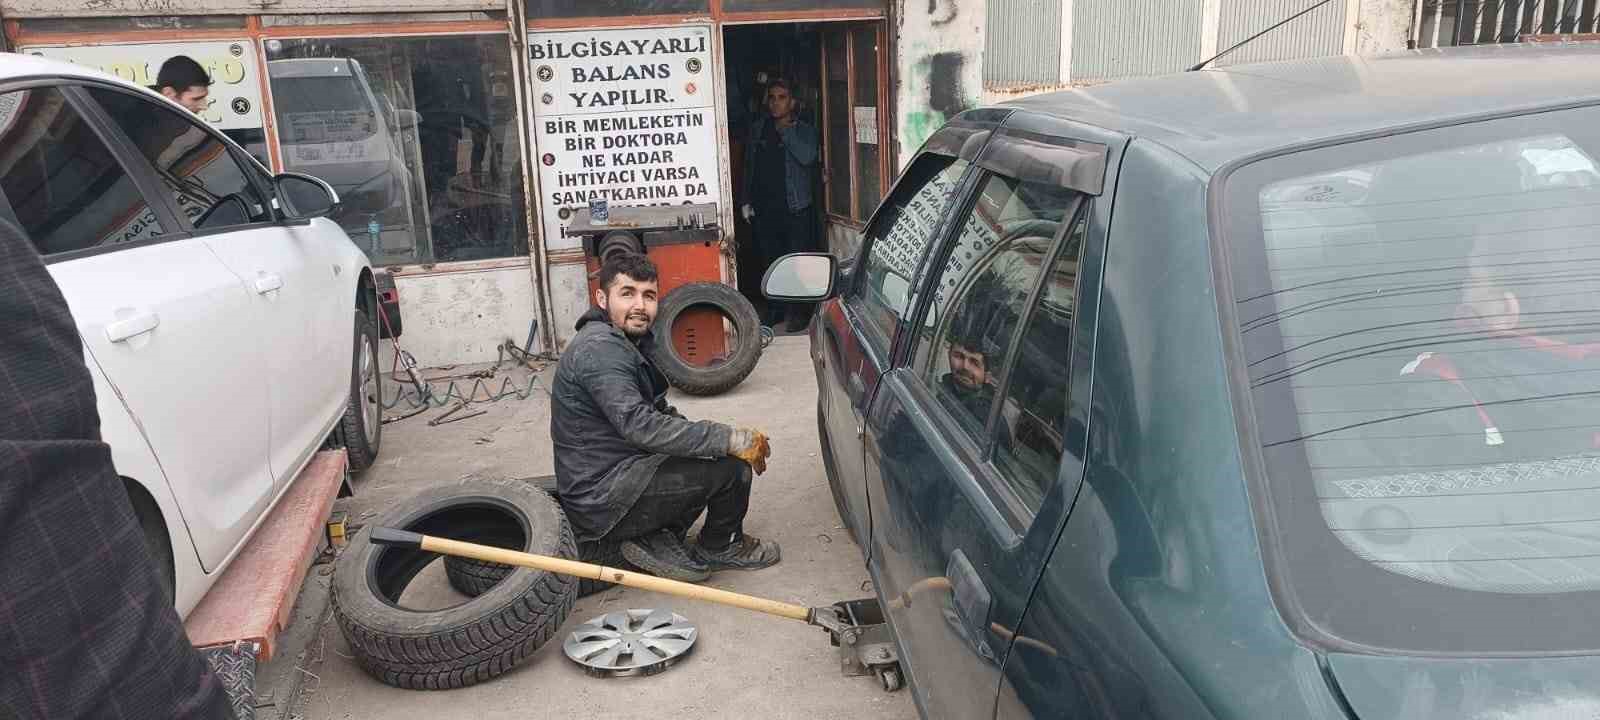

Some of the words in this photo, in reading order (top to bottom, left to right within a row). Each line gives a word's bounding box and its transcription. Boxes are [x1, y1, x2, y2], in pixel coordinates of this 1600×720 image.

[529, 37, 706, 60] BİLGİSAYARLI
[571, 63, 671, 83] BALANS
[569, 88, 675, 108] YAPILIR.
[545, 117, 577, 135] BİR
[583, 111, 703, 133] MEMLEKETİN
[565, 134, 596, 151] BİR
[603, 132, 688, 149] DOKTORA
[582, 154, 606, 168] NE
[613, 150, 673, 166] KADAR
[558, 169, 635, 187] İHTİYACI
[642, 166, 699, 181] VARSA
[552, 185, 679, 205] SANATKARINA
[685, 183, 708, 196] DA
